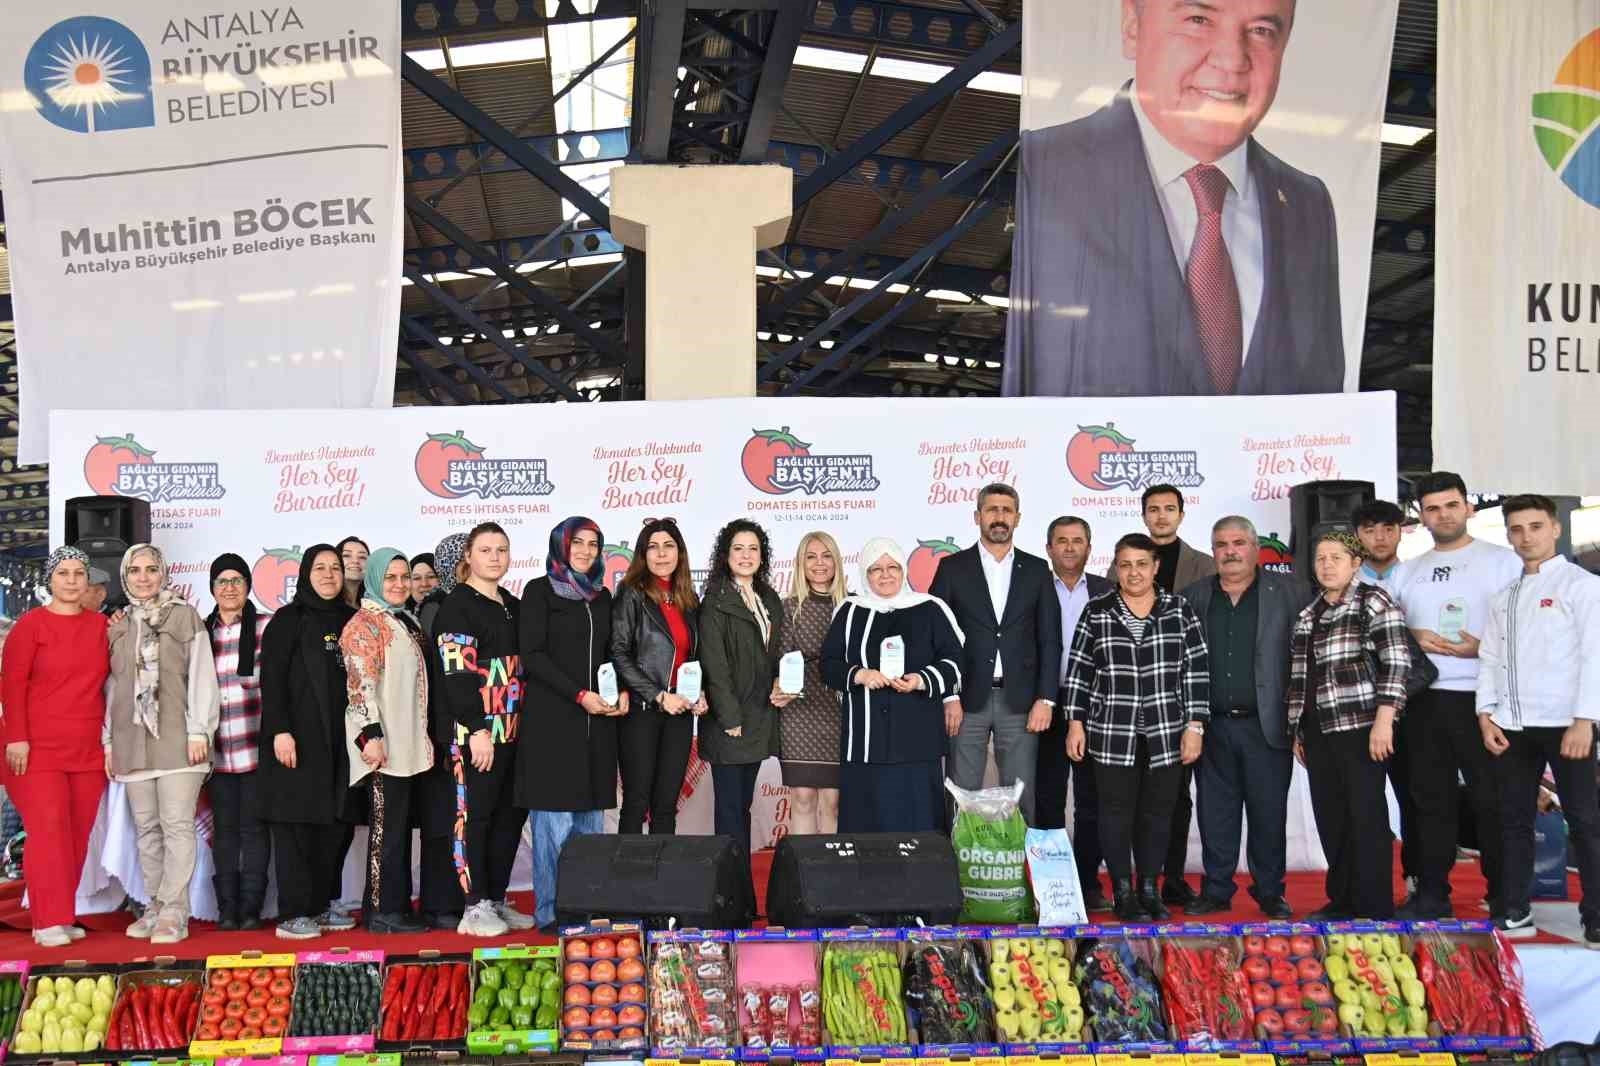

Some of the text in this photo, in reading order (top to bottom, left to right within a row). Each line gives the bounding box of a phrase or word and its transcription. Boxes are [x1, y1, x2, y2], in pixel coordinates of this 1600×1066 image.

[161, 7, 304, 44] ANTALYA
[61, 197, 374, 257] Muhittin BÖCEK
[65, 230, 376, 275] Antalya Büyükşehir Belediye Başkanı
[450, 461, 545, 471] SAĞLIKLI GIDANIN
[776, 456, 870, 466] SAĞLIKLI GIDANIN
[933, 453, 1010, 481] Her Şey
[1101, 453, 1195, 463] SAĞLIKLI GIDANIN
[1257, 449, 1334, 477] Her Şey
[120, 464, 216, 474] SAĞLIKLI GIDANIN
[280, 460, 359, 491] Her Şey
[608, 457, 687, 487] Her Şey
[155, 484, 224, 501] Kumluca
[485, 479, 553, 498] Kumluca
[811, 476, 878, 494] Kumluca
[273, 483, 366, 514] Burada!
[602, 479, 692, 510] Burada!
[1072, 497, 1122, 506] DOMATES
[188, 508, 221, 518] FUARI
[421, 503, 550, 515] DOMATES İHTİSAS FUARI
[747, 499, 876, 511] DOMATES İHTİSAS FUARI
[806, 513, 828, 521] OCAK
